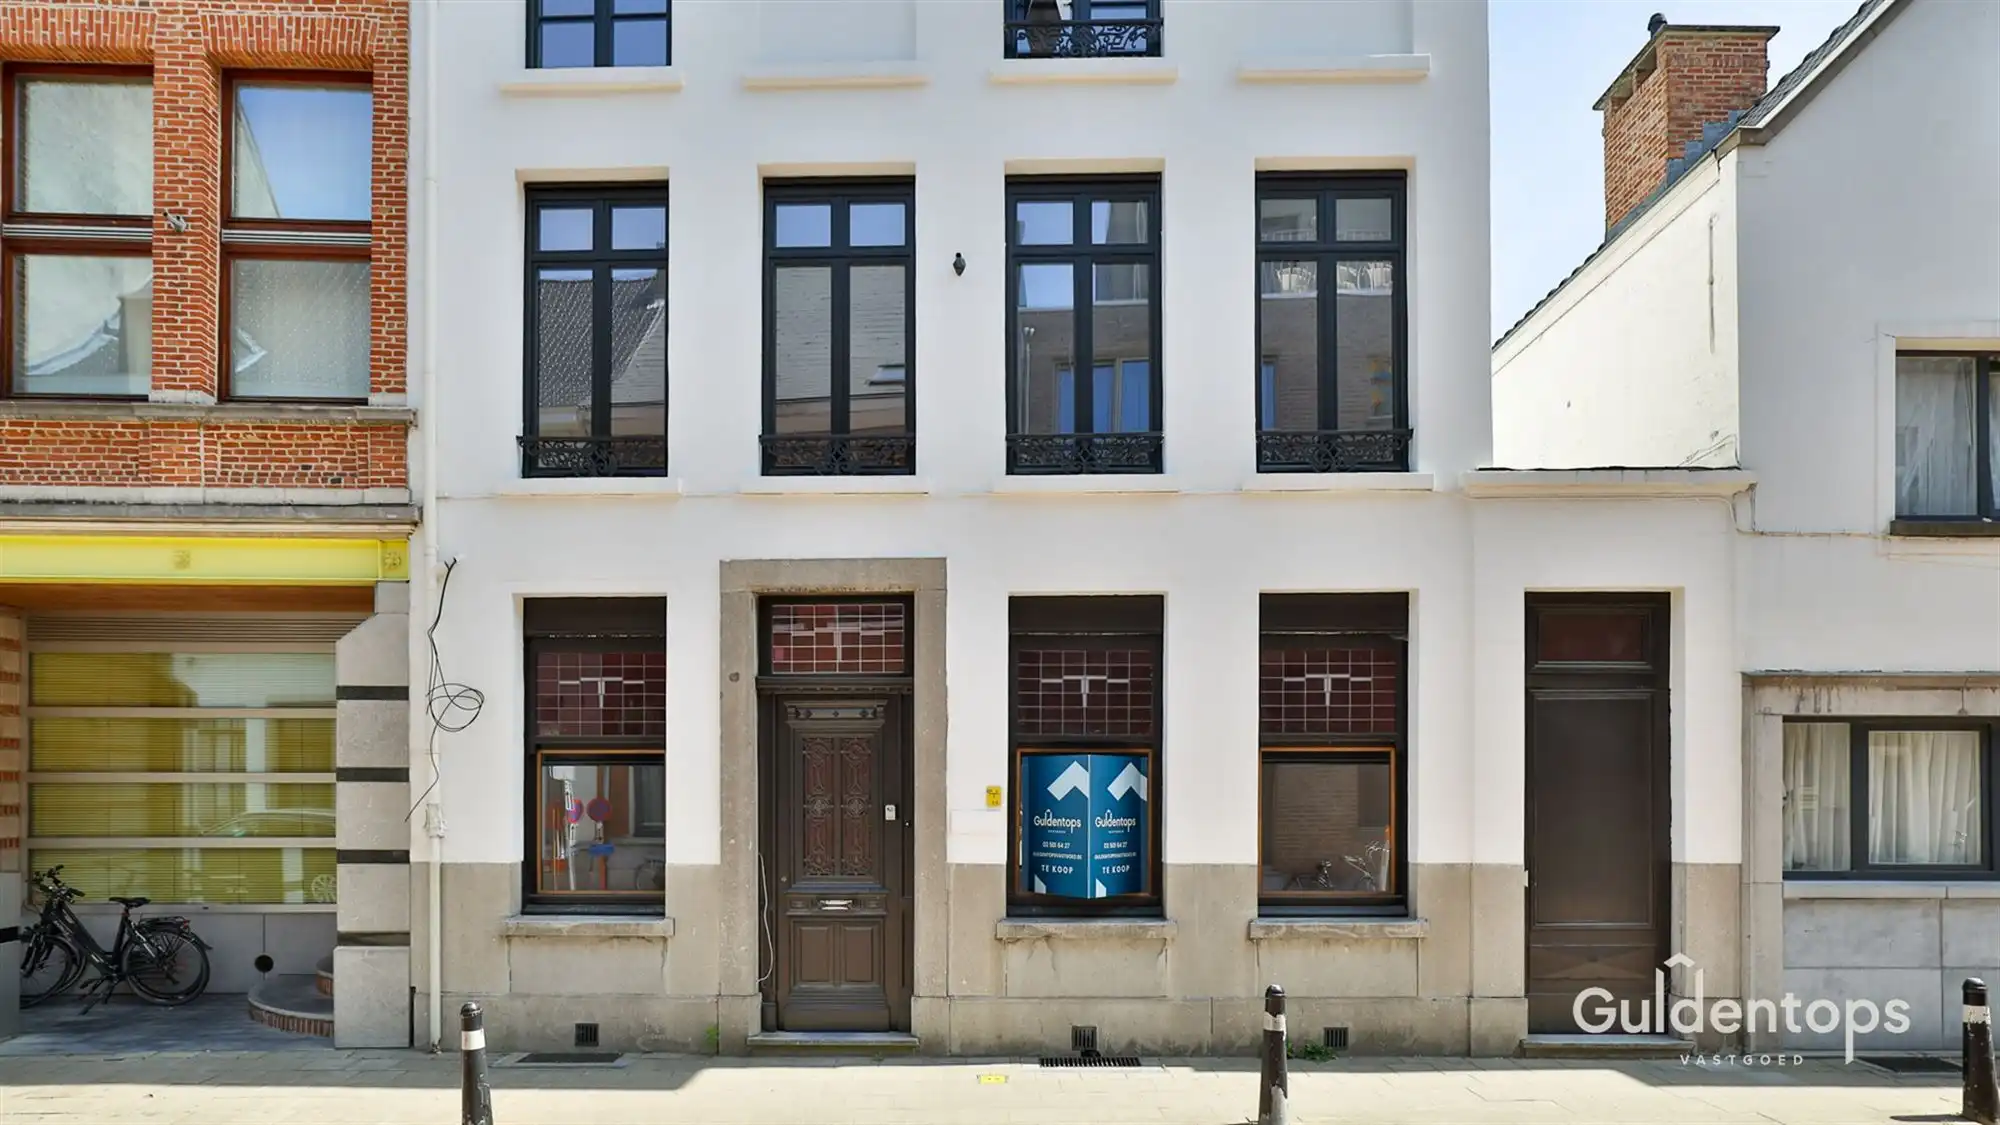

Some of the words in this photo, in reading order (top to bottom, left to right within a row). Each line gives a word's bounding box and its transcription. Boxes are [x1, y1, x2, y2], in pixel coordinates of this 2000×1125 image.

[1033, 809, 1082, 834] Guldentops
[1095, 809, 1136, 832] Guldentops
[1041, 864, 1050, 873] TE
[1051, 865, 1074, 874] KOOP
[1102, 866, 1110, 874] TE
[1111, 864, 1130, 873] KOOP
